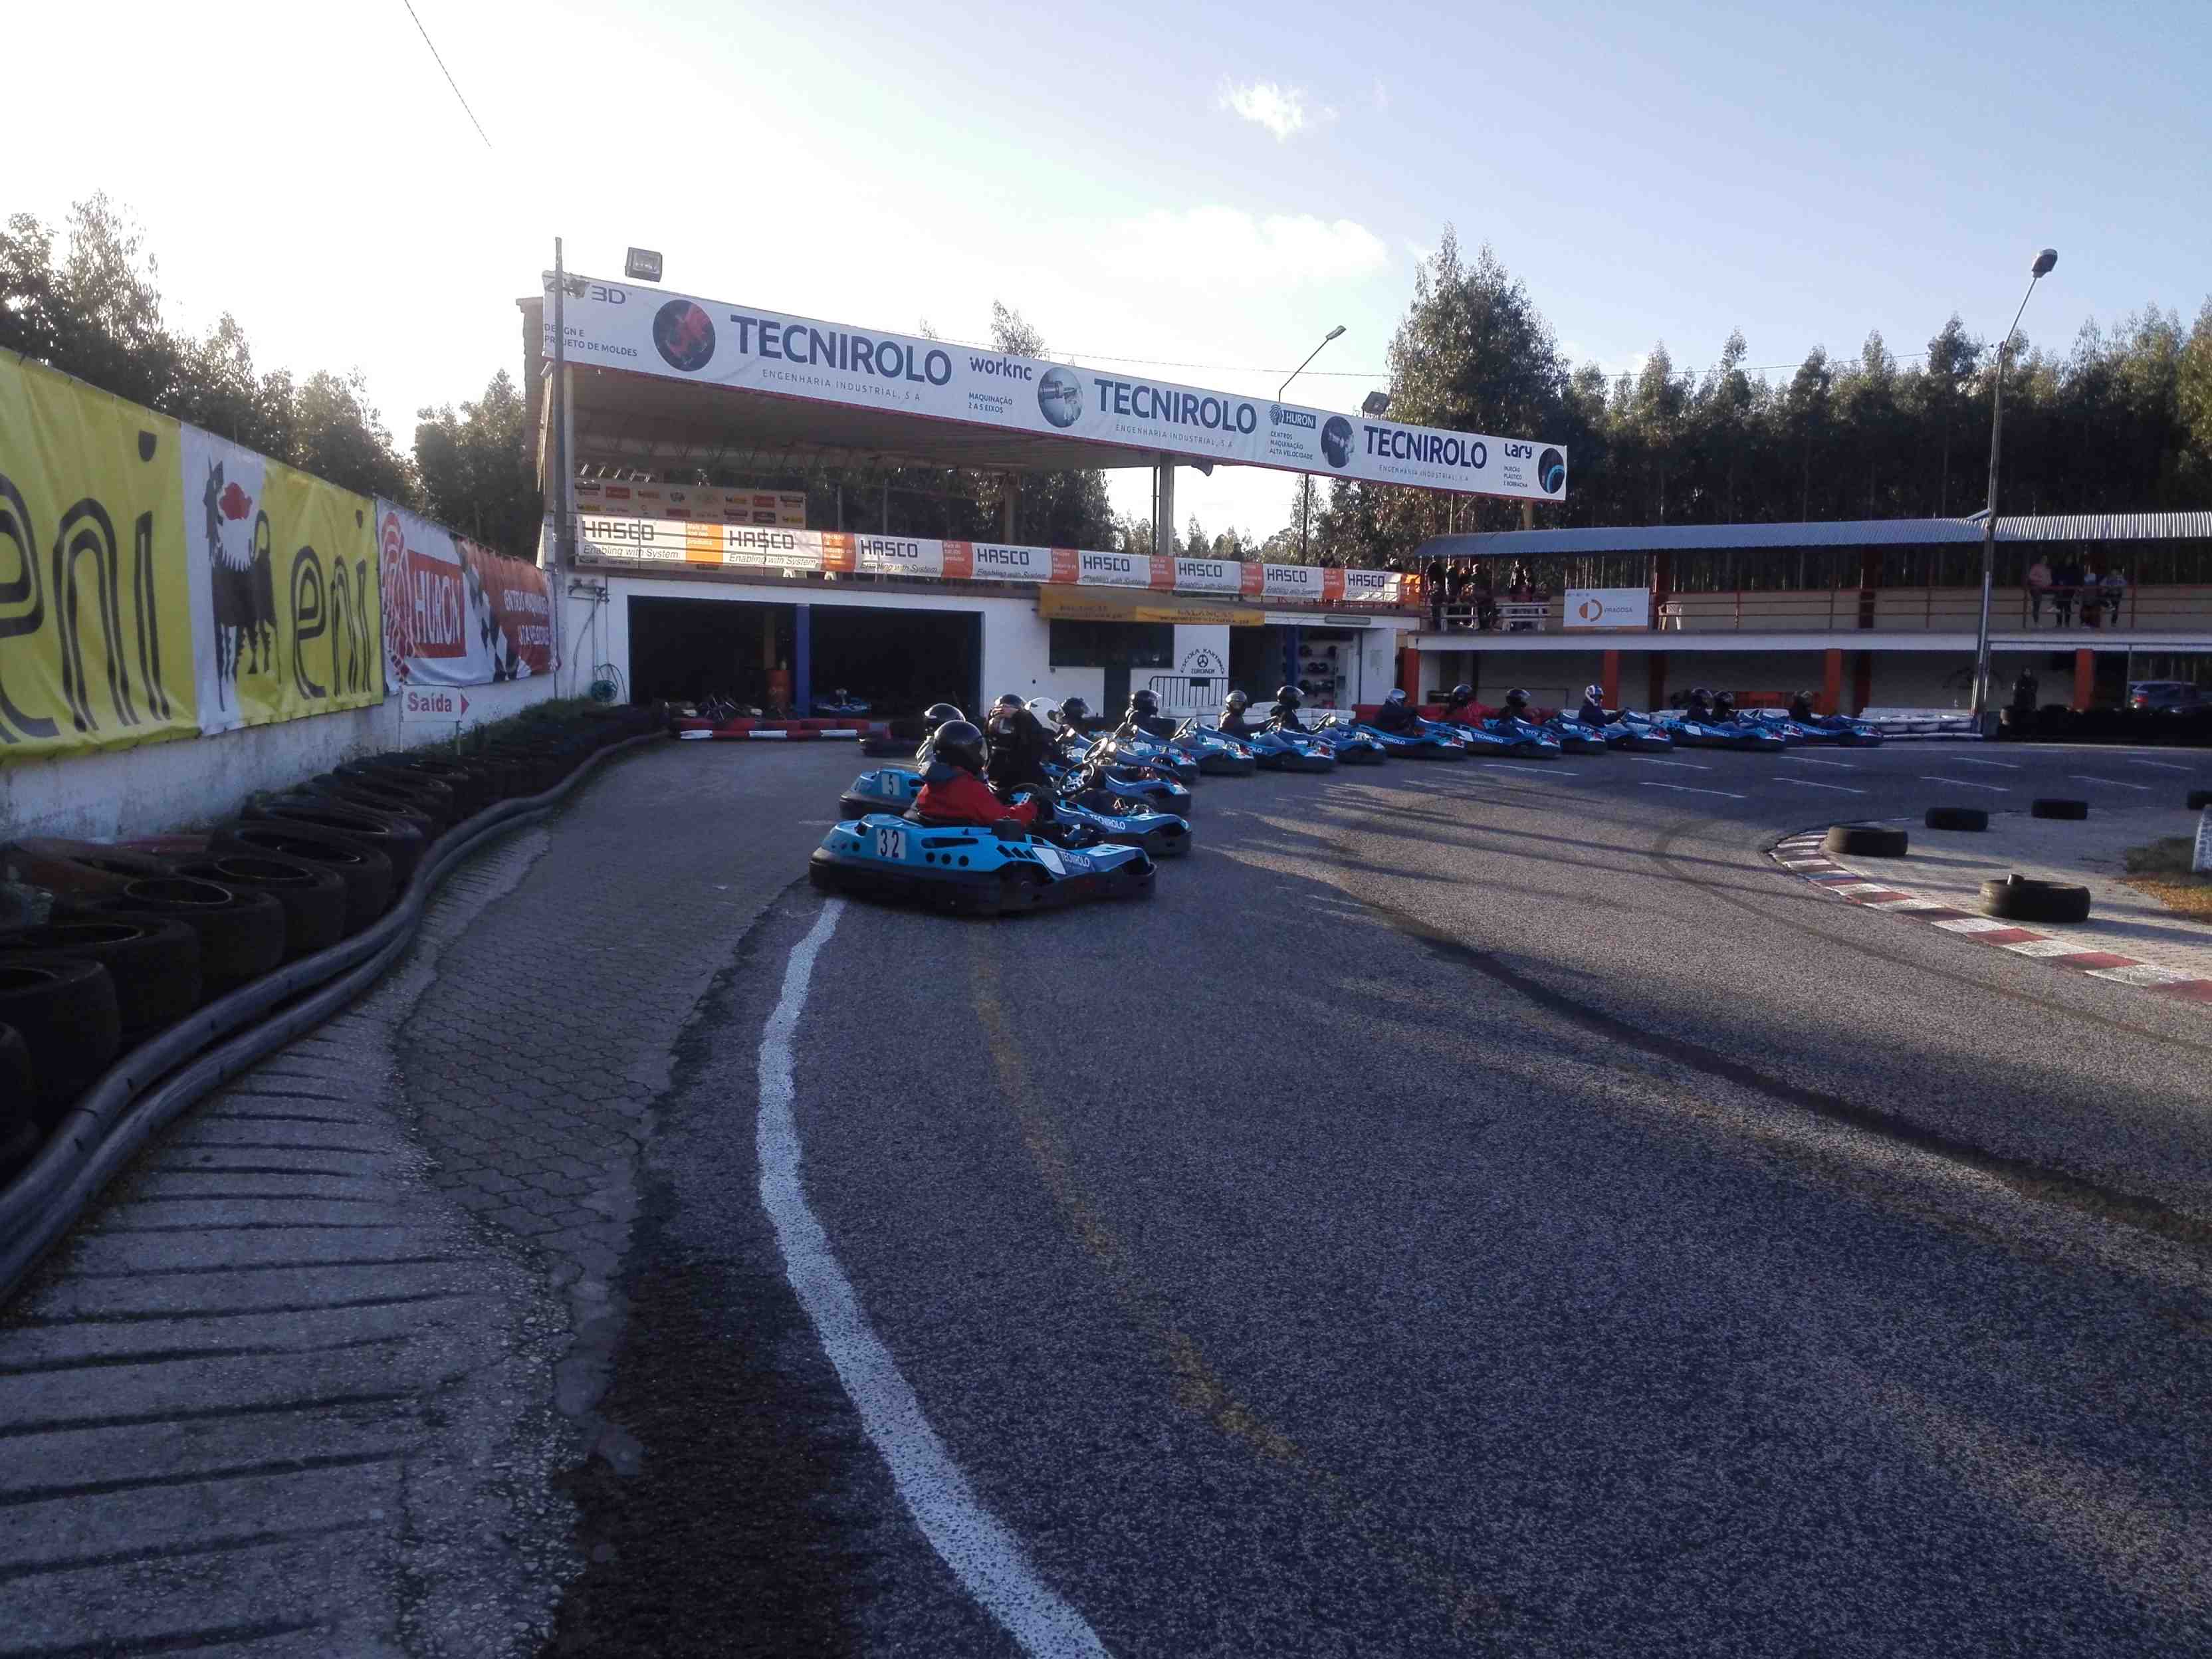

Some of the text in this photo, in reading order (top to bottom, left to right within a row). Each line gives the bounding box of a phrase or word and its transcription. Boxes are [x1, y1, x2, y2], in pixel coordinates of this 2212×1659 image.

[591, 285, 626, 304] 3D
[544, 324, 577, 336] DEGN
[544, 335, 638, 357] PRJETO DE MOLDES
[730, 314, 952, 386] TECNIROLO
[969, 356, 1032, 381] worknc
[762, 369, 831, 388] ENGENHARIA
[968, 392, 1013, 406] MAQUINAÇÃO
[1094, 378, 1257, 434] TECNIROLO
[985, 405, 1004, 414] EIXOS
[1286, 411, 1314, 427] HURON
[1116, 424, 1167, 439] ENGENHARIA
[1364, 425, 1488, 469] TECNIROLO
[582, 520, 655, 541] HASCO
[730, 530, 794, 550] HASCO
[584, 545, 623, 556] Enabling
[626, 547, 644, 556] with
[860, 539, 918, 558] HASCO
[977, 548, 1030, 566] HASCO
[729, 554, 766, 564] Enabling
[768, 554, 784, 564] with
[1083, 556, 1130, 572] HASCO
[1179, 562, 1222, 577] HASCO
[1266, 568, 1307, 583] HASCO
[1347, 574, 1385, 588] HASCO
[290, 510, 372, 700] eni
[413, 570, 461, 645] HURON
[407, 691, 453, 713] Saída
[887, 774, 894, 796] 5
[1088, 813, 1126, 830] TECNIROLO
[880, 829, 899, 857] 32
